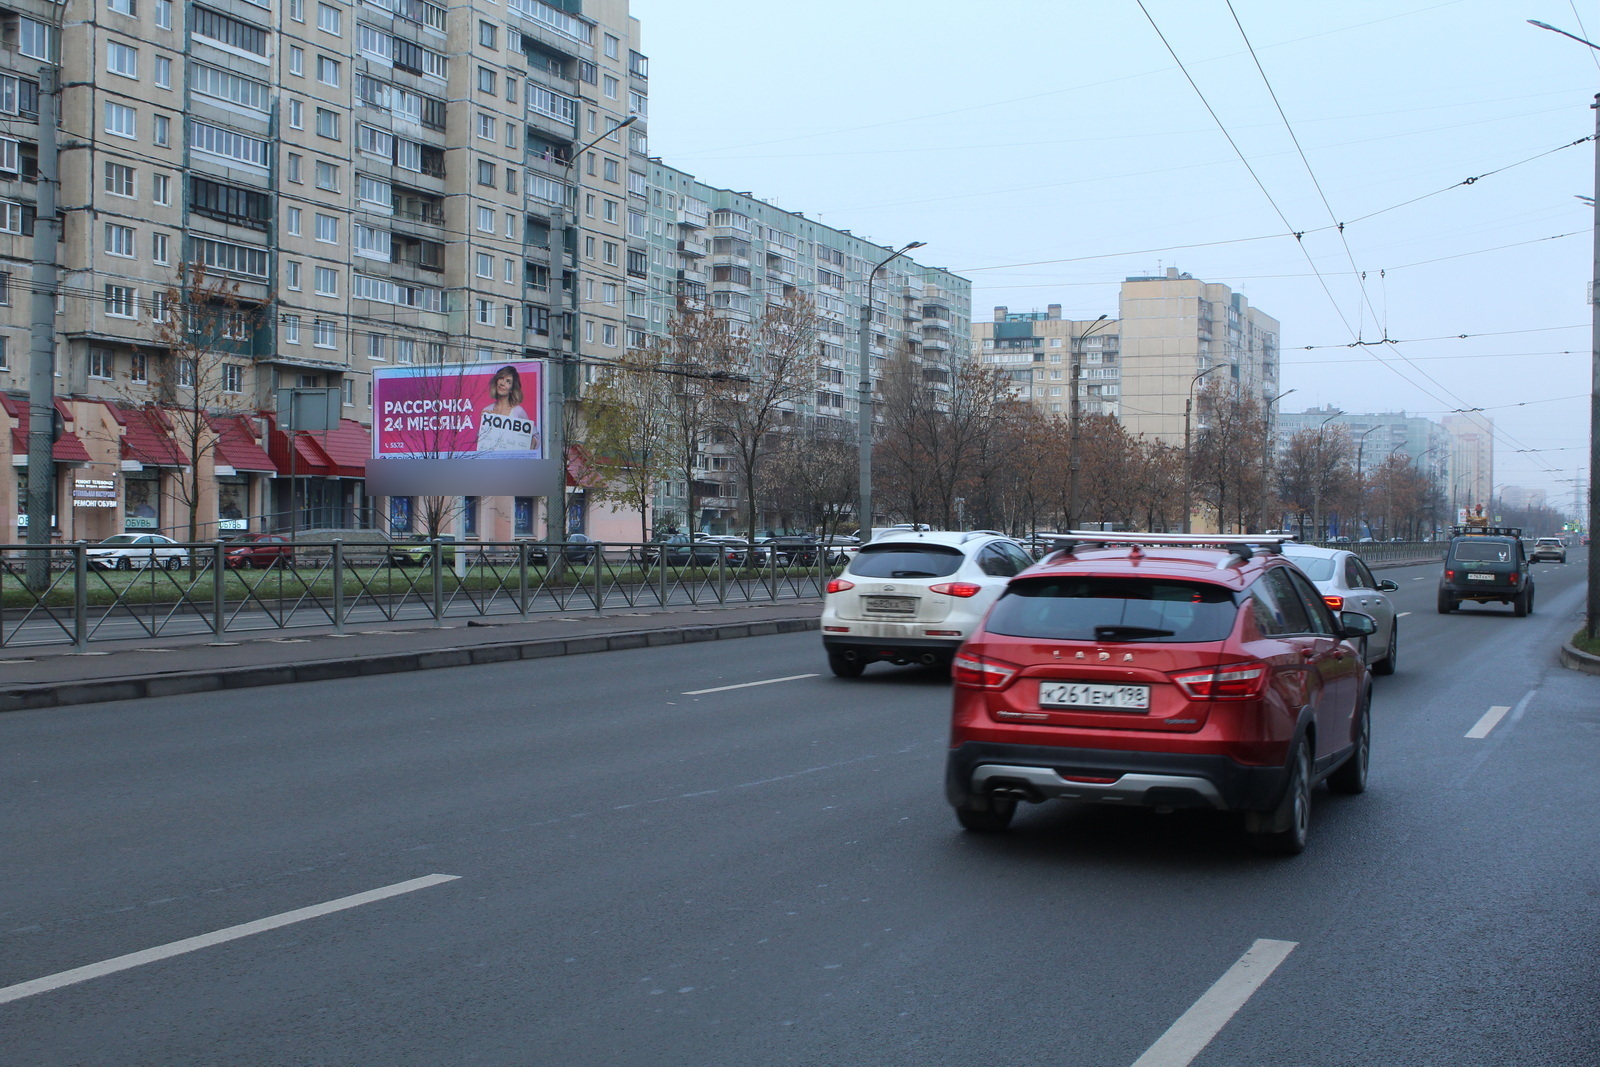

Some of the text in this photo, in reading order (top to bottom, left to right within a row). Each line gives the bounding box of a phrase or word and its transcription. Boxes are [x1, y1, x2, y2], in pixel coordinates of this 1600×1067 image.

[384, 398, 473, 415] РАССРОЧКА
[384, 415, 474, 432] 24 МЕСЯЦА
[73, 500, 118, 508] РЕМОНТ ОБУВИ
[125, 519, 151, 528] ОБУВЬ
[1053, 650, 1134, 662] LADA
